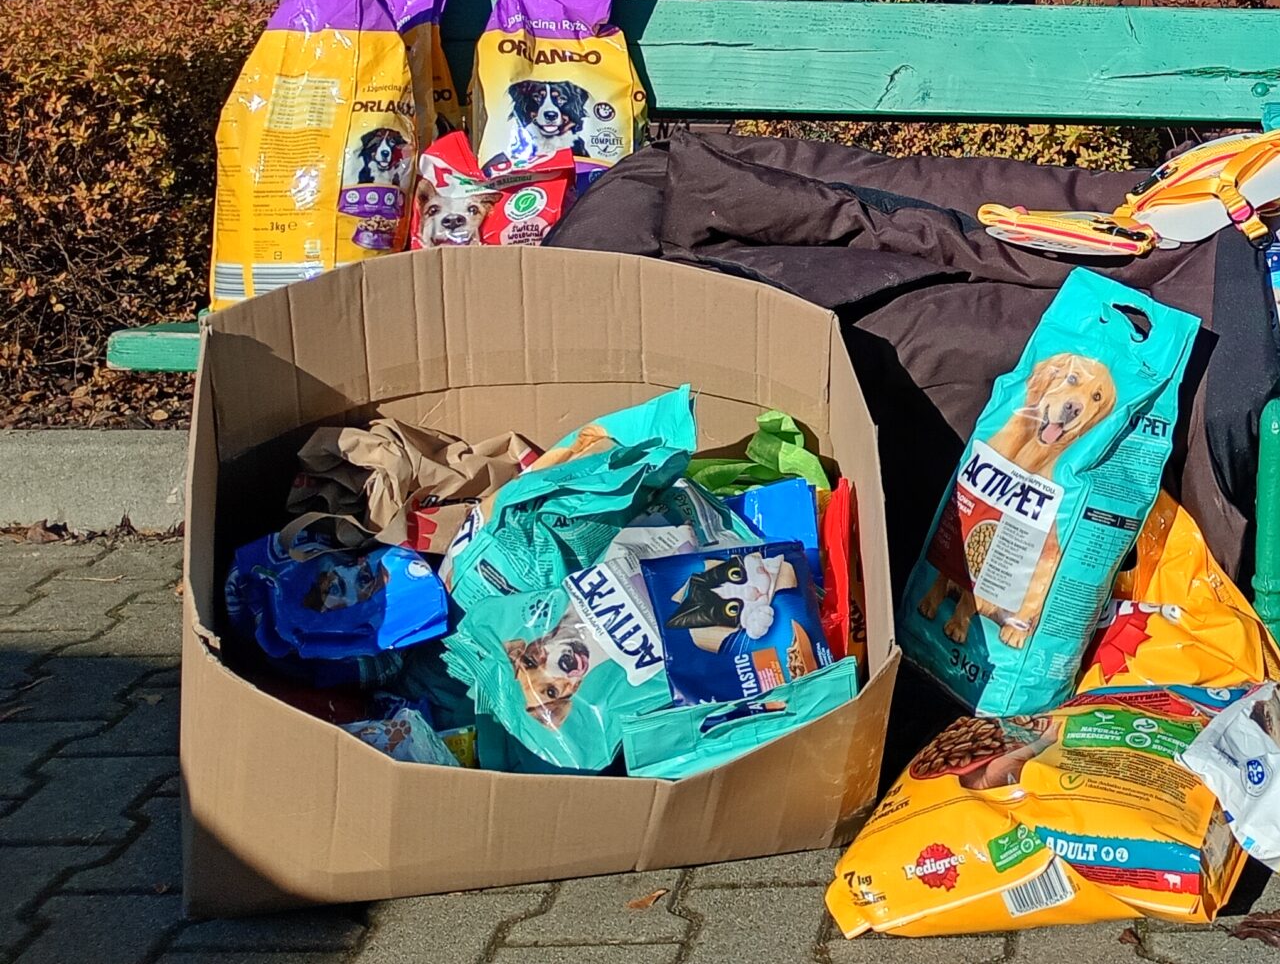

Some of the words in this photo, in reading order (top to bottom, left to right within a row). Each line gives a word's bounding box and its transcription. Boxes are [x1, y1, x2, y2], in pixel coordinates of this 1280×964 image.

[498, 39, 601, 65] ORLANDO
[591, 137, 624, 146] COMPLETE
[275, 222, 286, 233] kg
[961, 453, 1054, 522] ACTIVPET
[569, 565, 664, 670] ACTIVPET
[950, 649, 962, 666] 3
[961, 657, 980, 683] kg
[1066, 732, 1122, 741] INGREDIENTS
[1045, 836, 1098, 862] ADULT
[843, 871, 856, 888] 7
[857, 874, 873, 886] kg
[903, 854, 966, 880] Pedigree
